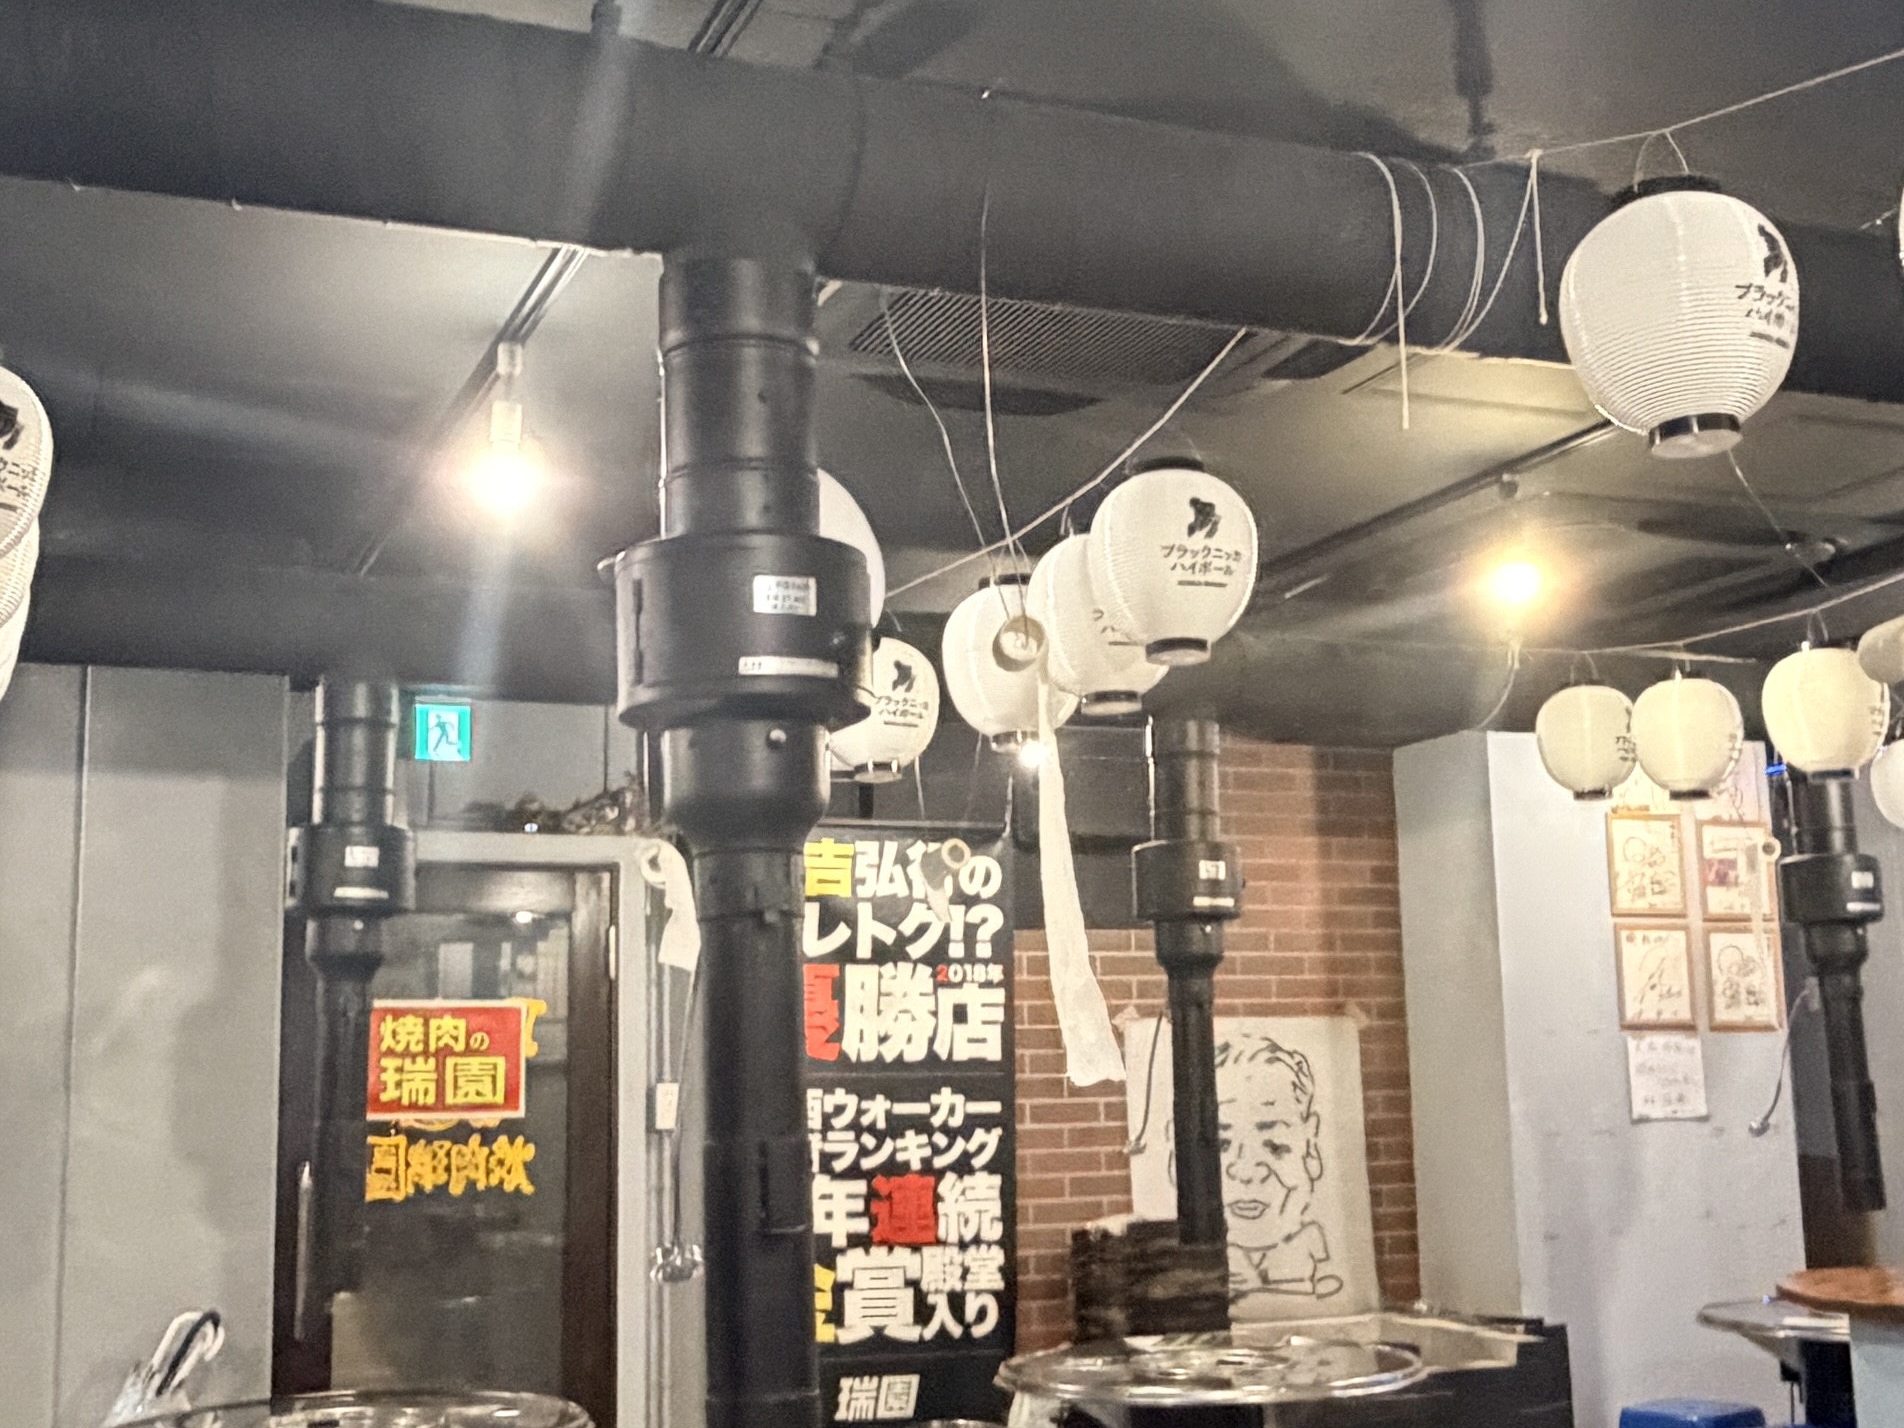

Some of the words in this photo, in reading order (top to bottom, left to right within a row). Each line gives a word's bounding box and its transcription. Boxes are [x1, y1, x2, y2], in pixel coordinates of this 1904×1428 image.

[380, 1014, 491, 1053] 焼肉の
[379, 1055, 507, 1106] 瑞園
[834, 1373, 921, 1422] 瑞園
